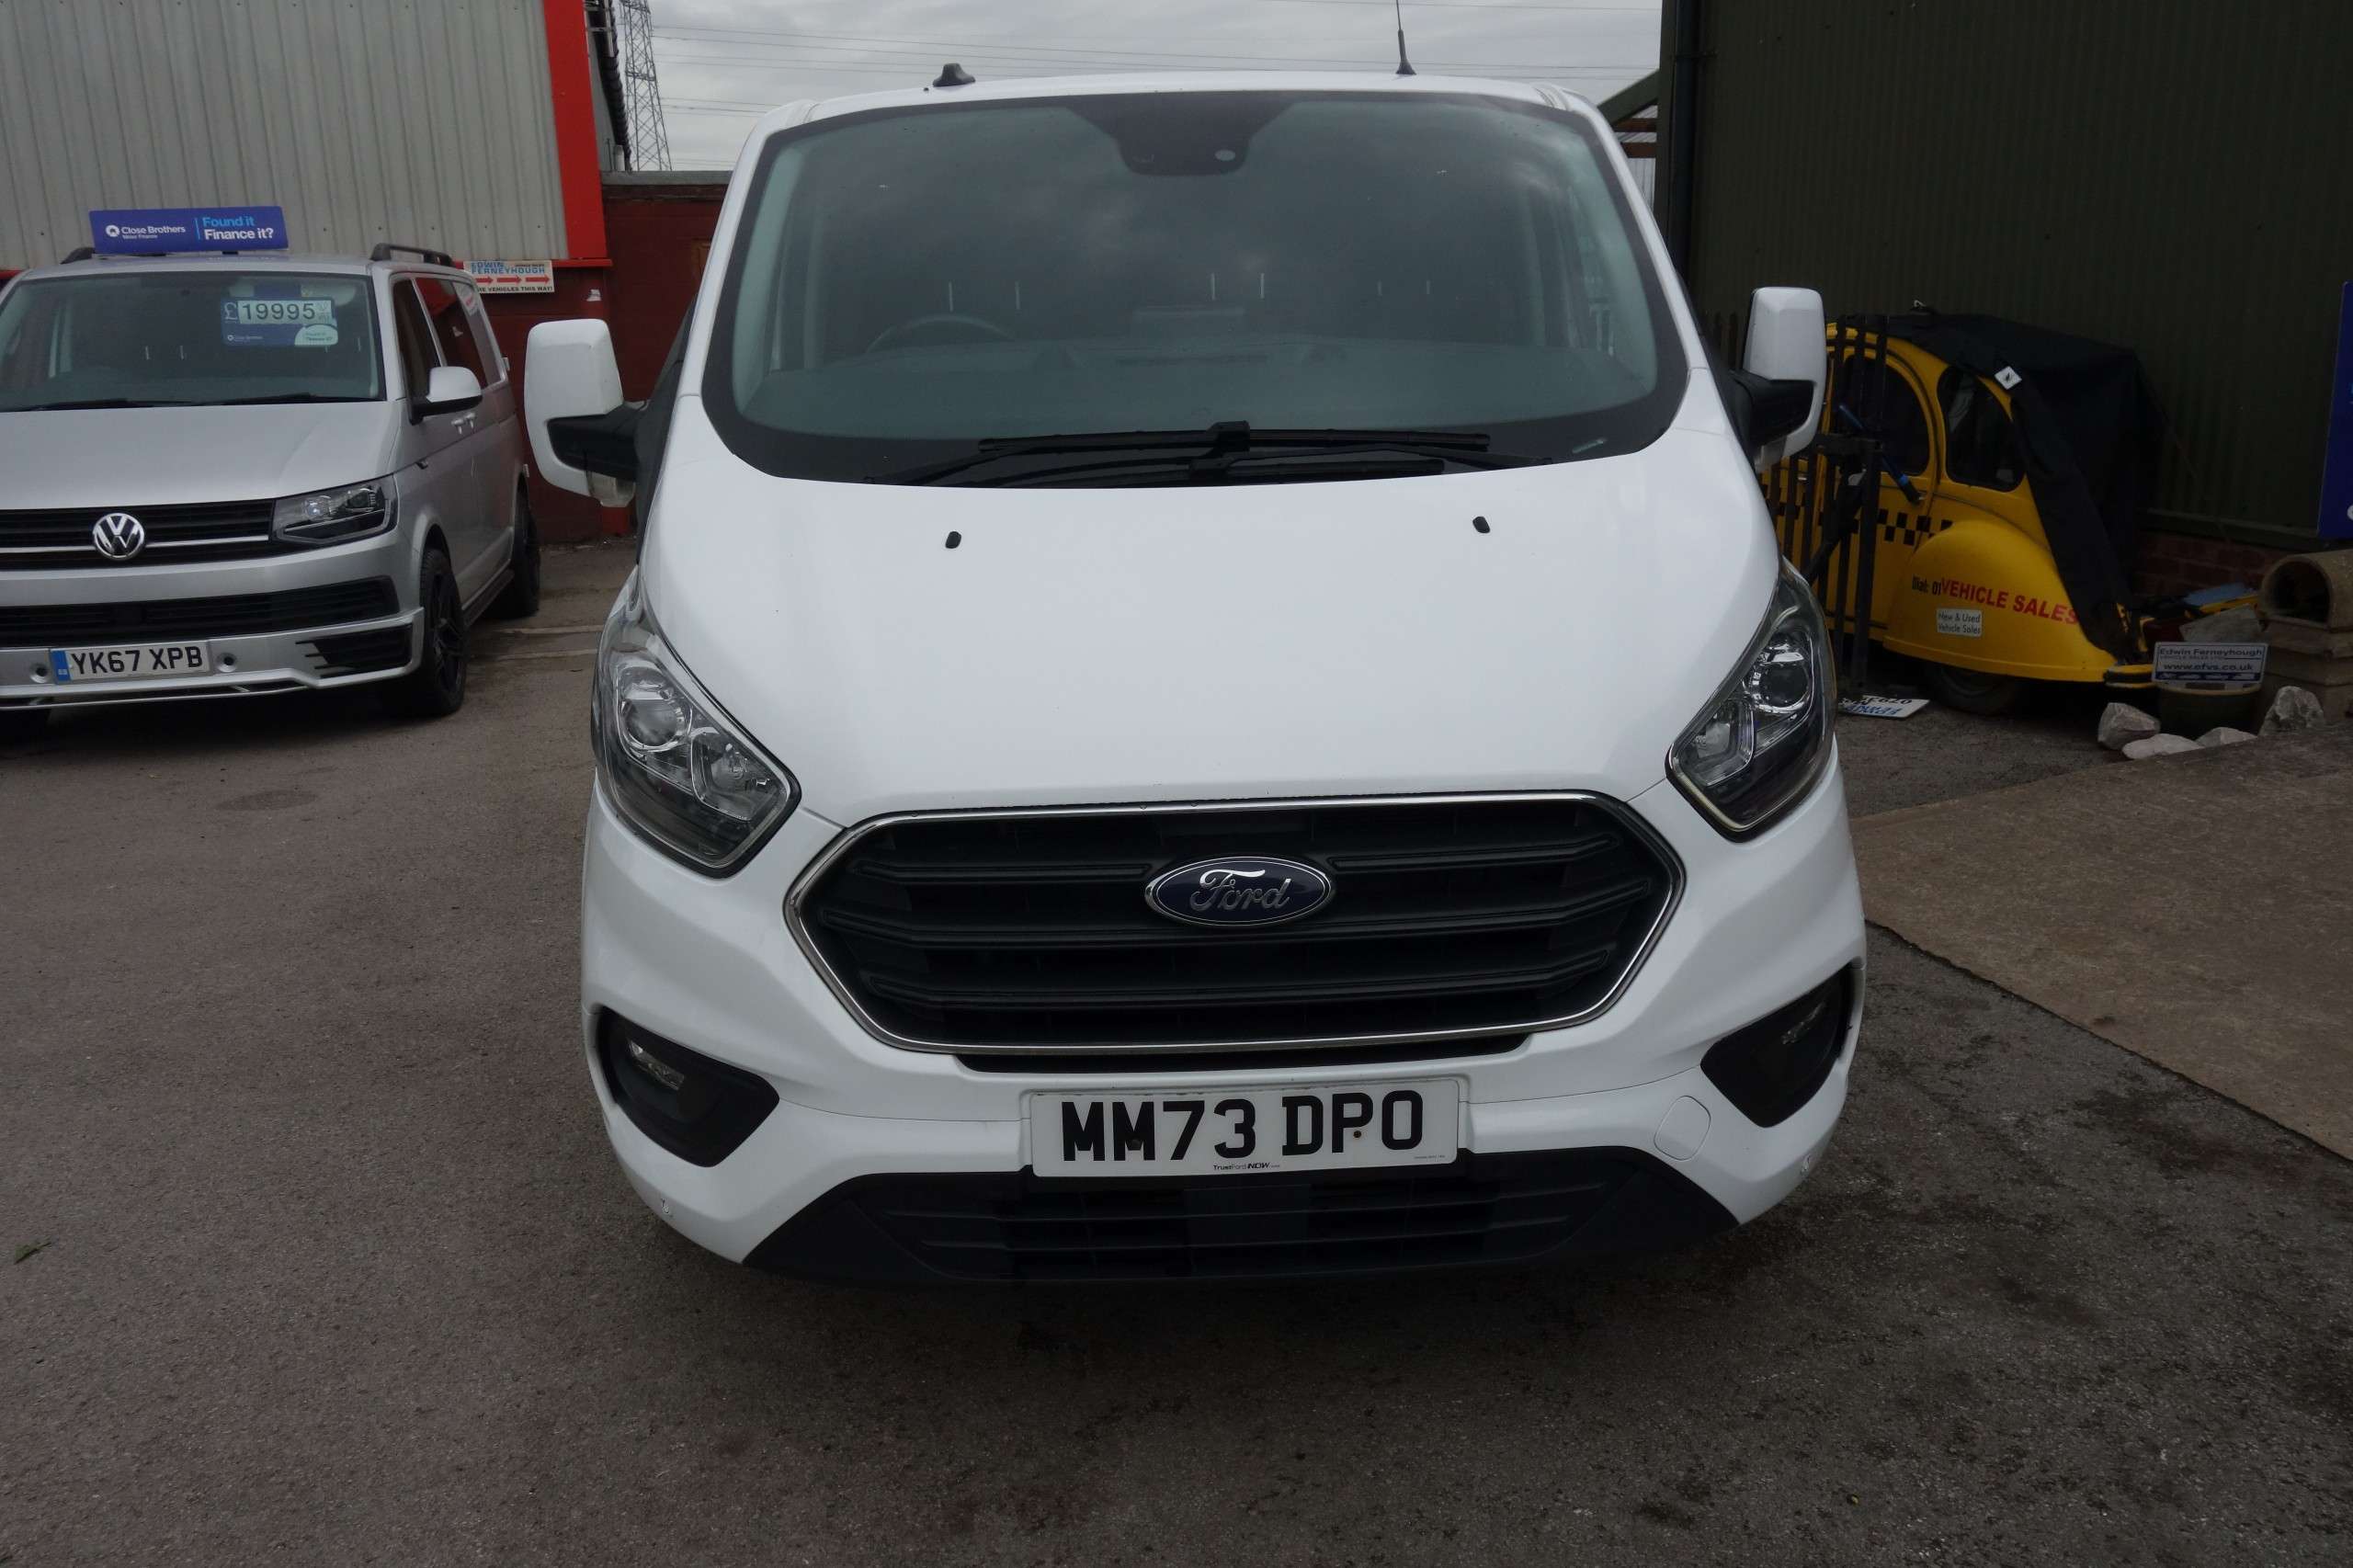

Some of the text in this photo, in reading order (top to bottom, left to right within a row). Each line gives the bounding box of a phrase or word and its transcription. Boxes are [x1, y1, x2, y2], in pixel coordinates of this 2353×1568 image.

[202, 216, 256, 227] Found it
[121, 225, 186, 234] Close Brothers
[204, 227, 274, 240] Finance it?
[1941, 577, 2079, 625] VEHICLE SALES
[1938, 610, 1952, 621] New
[1962, 611, 1980, 623] Used
[1938, 621, 1981, 635] Vehicle Sales
[2193, 648, 2262, 657] Ferneyhough
[72, 646, 202, 674] YK67 XPB
[1189, 869, 1293, 911] Ford
[1062, 1089, 1423, 1162] MM73 DPO
